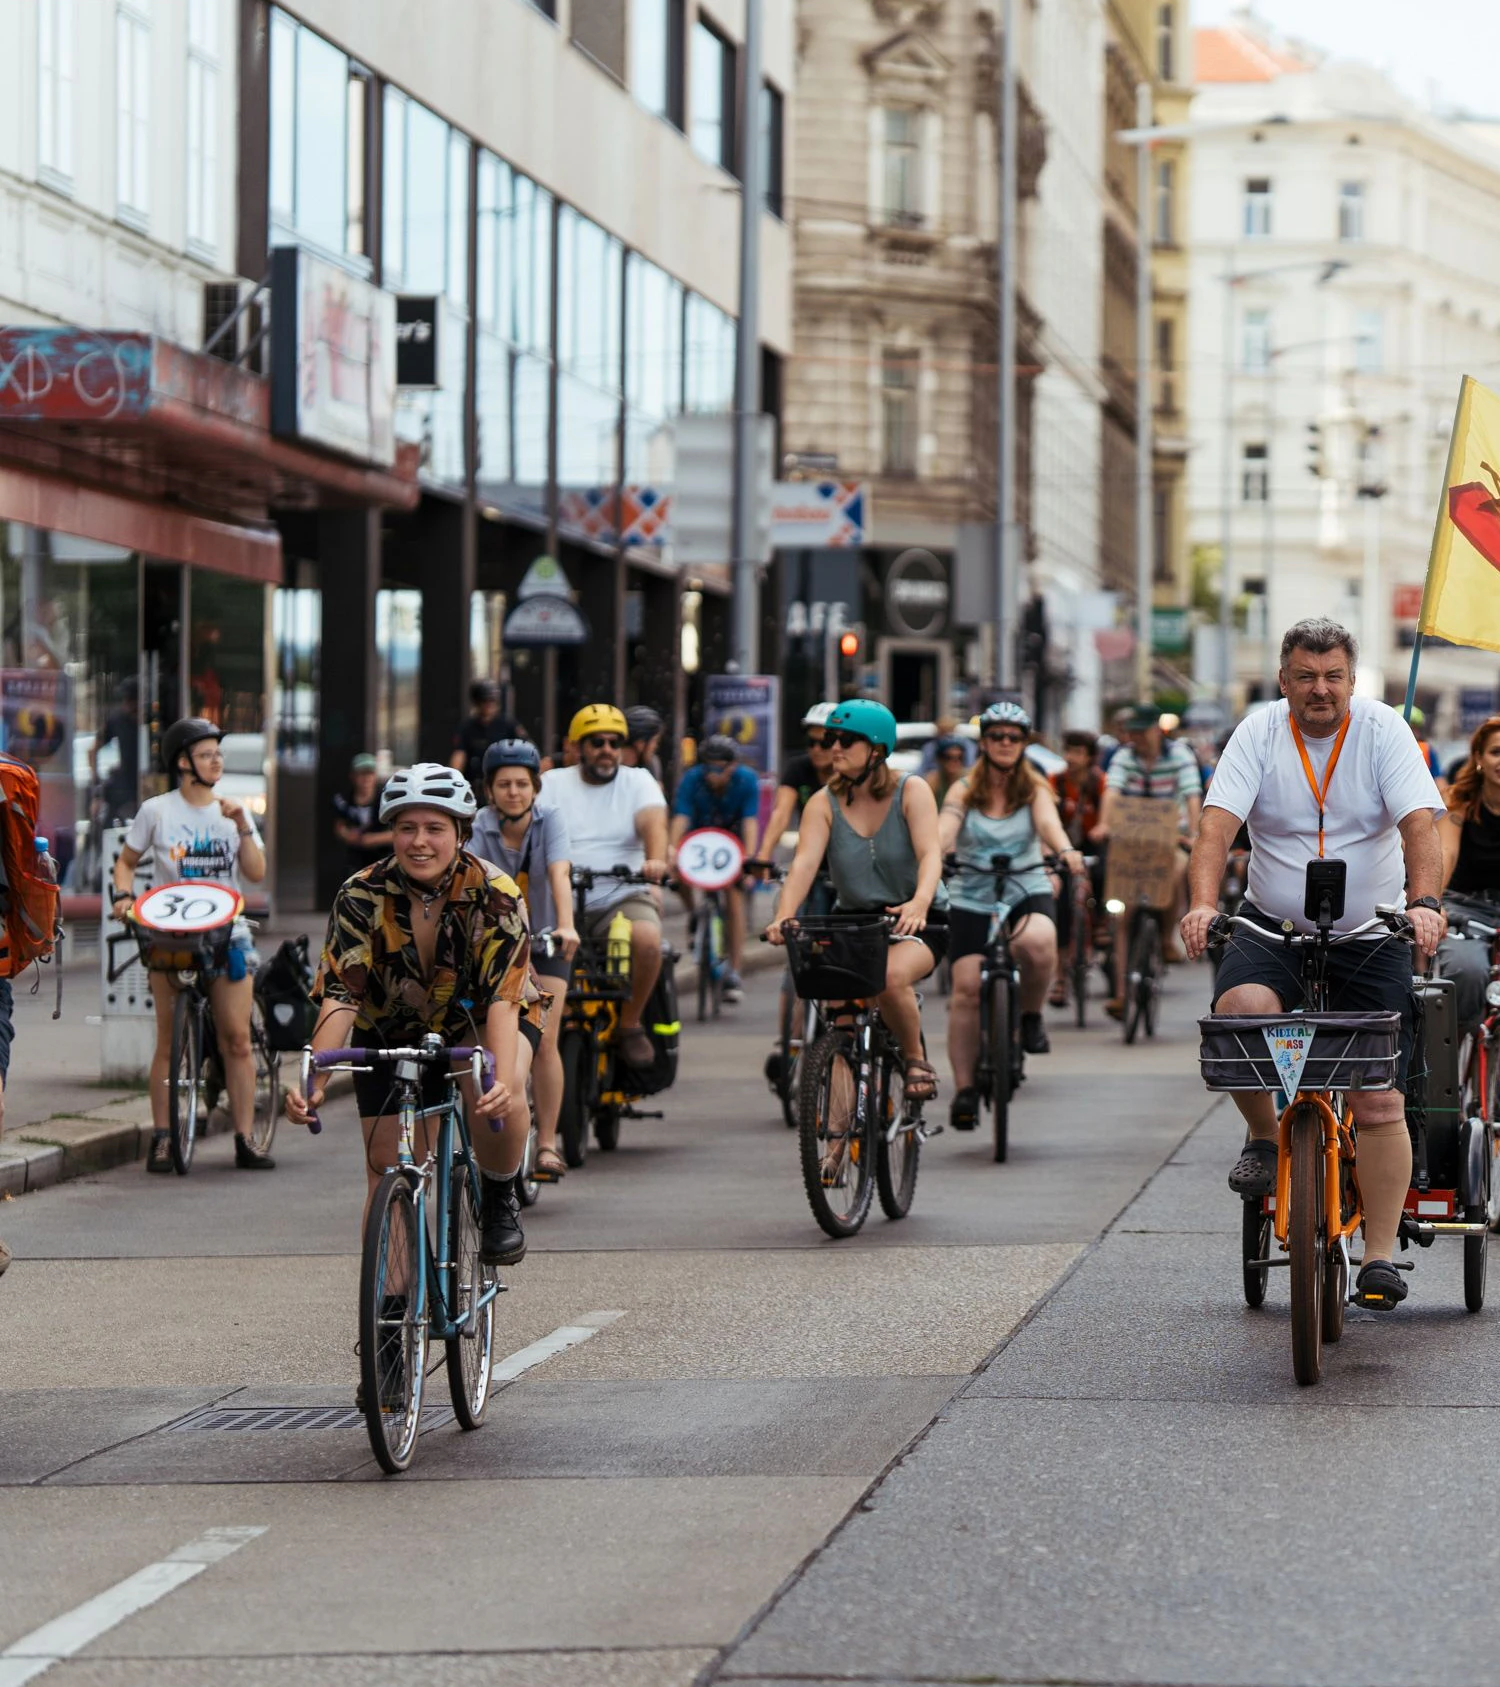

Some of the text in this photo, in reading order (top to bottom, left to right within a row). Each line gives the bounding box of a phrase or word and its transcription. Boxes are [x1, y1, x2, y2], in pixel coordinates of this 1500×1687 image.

[690, 844, 732, 870] 30
[154, 894, 218, 920] 30
[1267, 1027, 1311, 1037] KIDICAL
[1276, 1040, 1304, 1050] MASS
